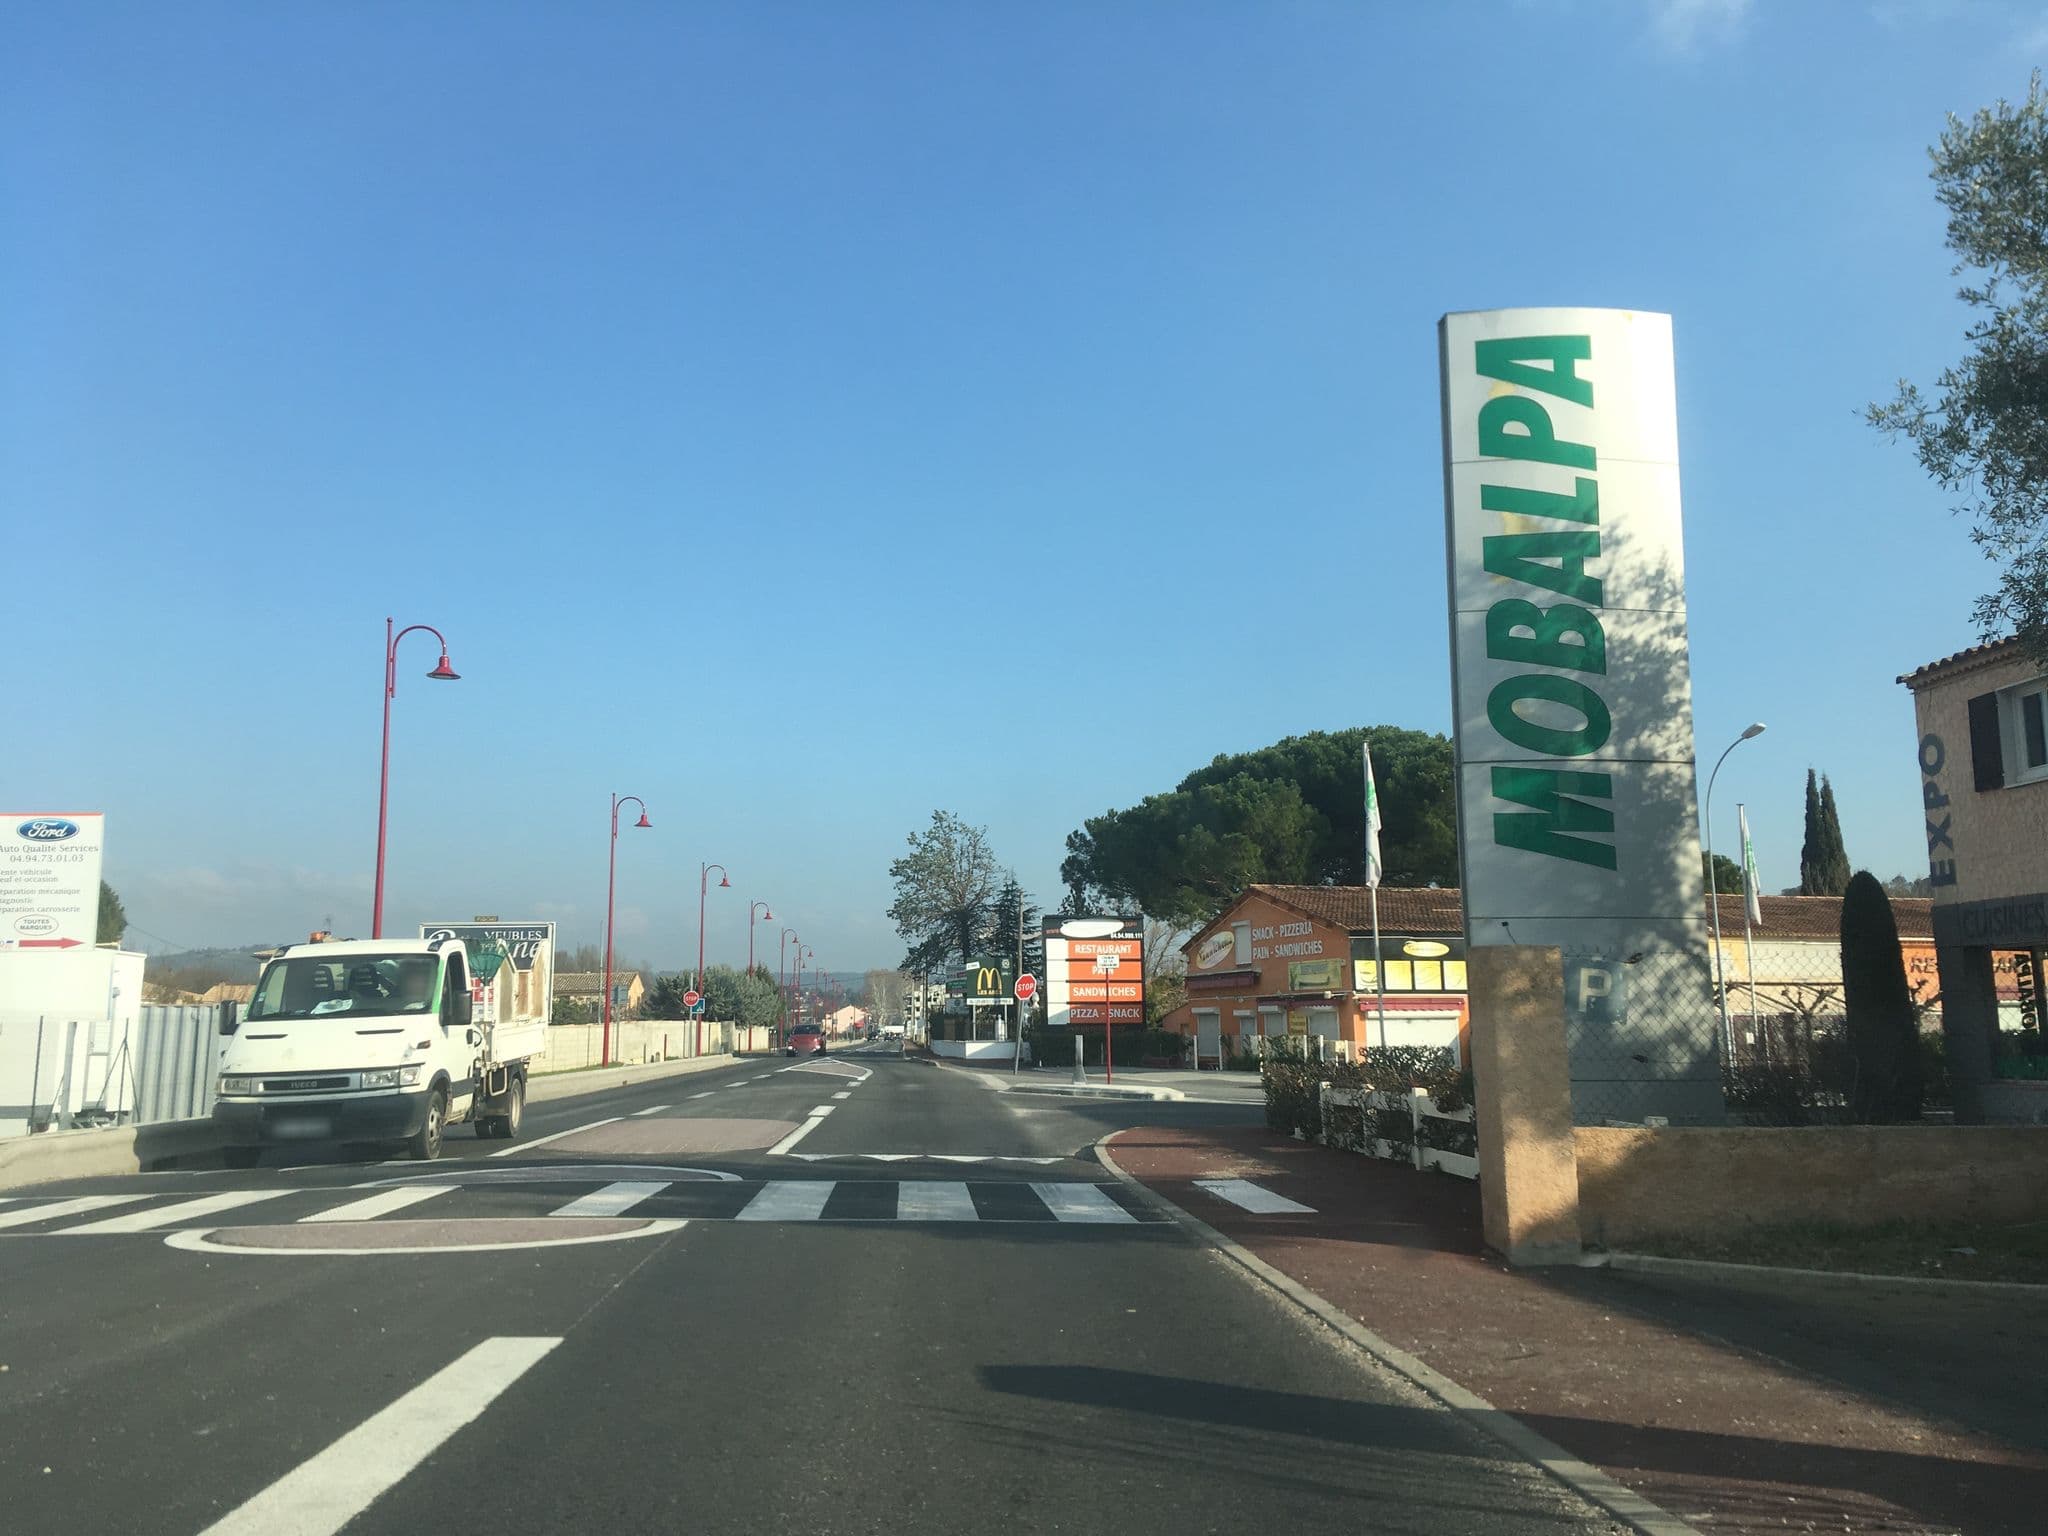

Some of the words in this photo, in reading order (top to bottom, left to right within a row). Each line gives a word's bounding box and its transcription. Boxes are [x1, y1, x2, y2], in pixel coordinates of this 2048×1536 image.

[1474, 334, 1618, 872] MOBALPA
[1918, 733, 1957, 888] EXPO
[27, 821, 69, 838] Ford
[0, 845, 20, 853] Auto
[59, 844, 99, 853] Services
[484, 930, 543, 941] MEUBLES
[1252, 926, 1275, 941] SNACK
[1279, 921, 1313, 938] PIZZERIA
[1074, 944, 1132, 953] RESTAURANT
[1252, 946, 1270, 960] PAIN
[1274, 940, 1323, 958] SANDWICHES
[1017, 983, 1034, 992] STOP
[1072, 986, 1137, 997] SANDWICHES
[1578, 967, 1613, 1010] P
[1070, 1008, 1099, 1018] PIZZA
[1108, 1008, 1141, 1018] SNACK
